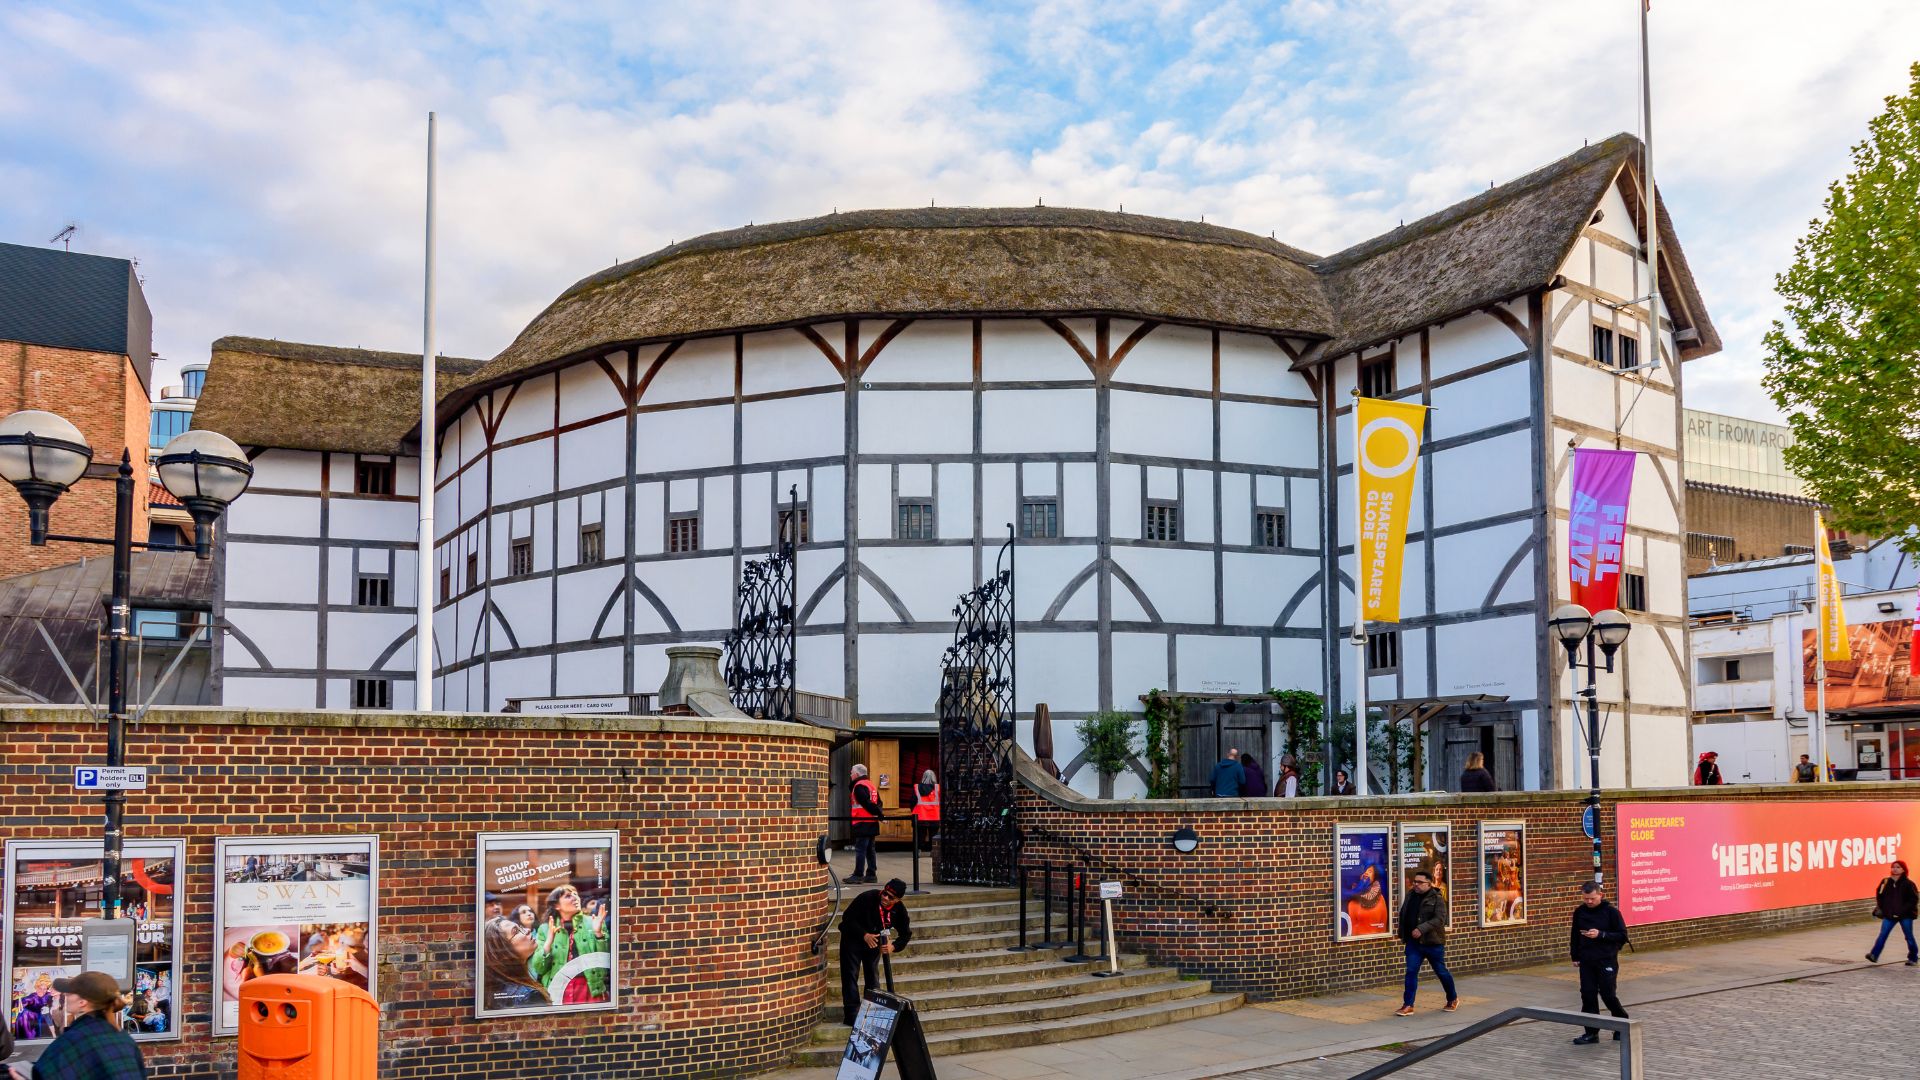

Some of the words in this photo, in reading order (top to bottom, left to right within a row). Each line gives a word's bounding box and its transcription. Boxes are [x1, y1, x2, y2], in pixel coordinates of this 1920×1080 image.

[1688, 418, 1712, 437] ART
[1718, 422, 1756, 445] FROM
[1362, 490, 1379, 540] GLOBE
[1570, 490, 1598, 587] ALIVE
[1594, 504, 1625, 581] FEEL
[1368, 491, 1394, 609] SHAKESPEARE'S
[80, 770, 95, 785] P
[1631, 816, 1685, 829] SHAKESPEARE'S
[1631, 830, 1655, 841] GLOBE
[1783, 840, 1803, 873] IS
[1807, 839, 1838, 870] MY
[495, 860, 530, 876] GROUP
[497, 868, 537, 885] GUIDED
[536, 858, 570, 874] TOURS
[257, 883, 342, 900] SWAN
[26, 925, 83, 935] SHAKESP
[136, 923, 165, 931] OBE
[136, 931, 165, 944] UR
